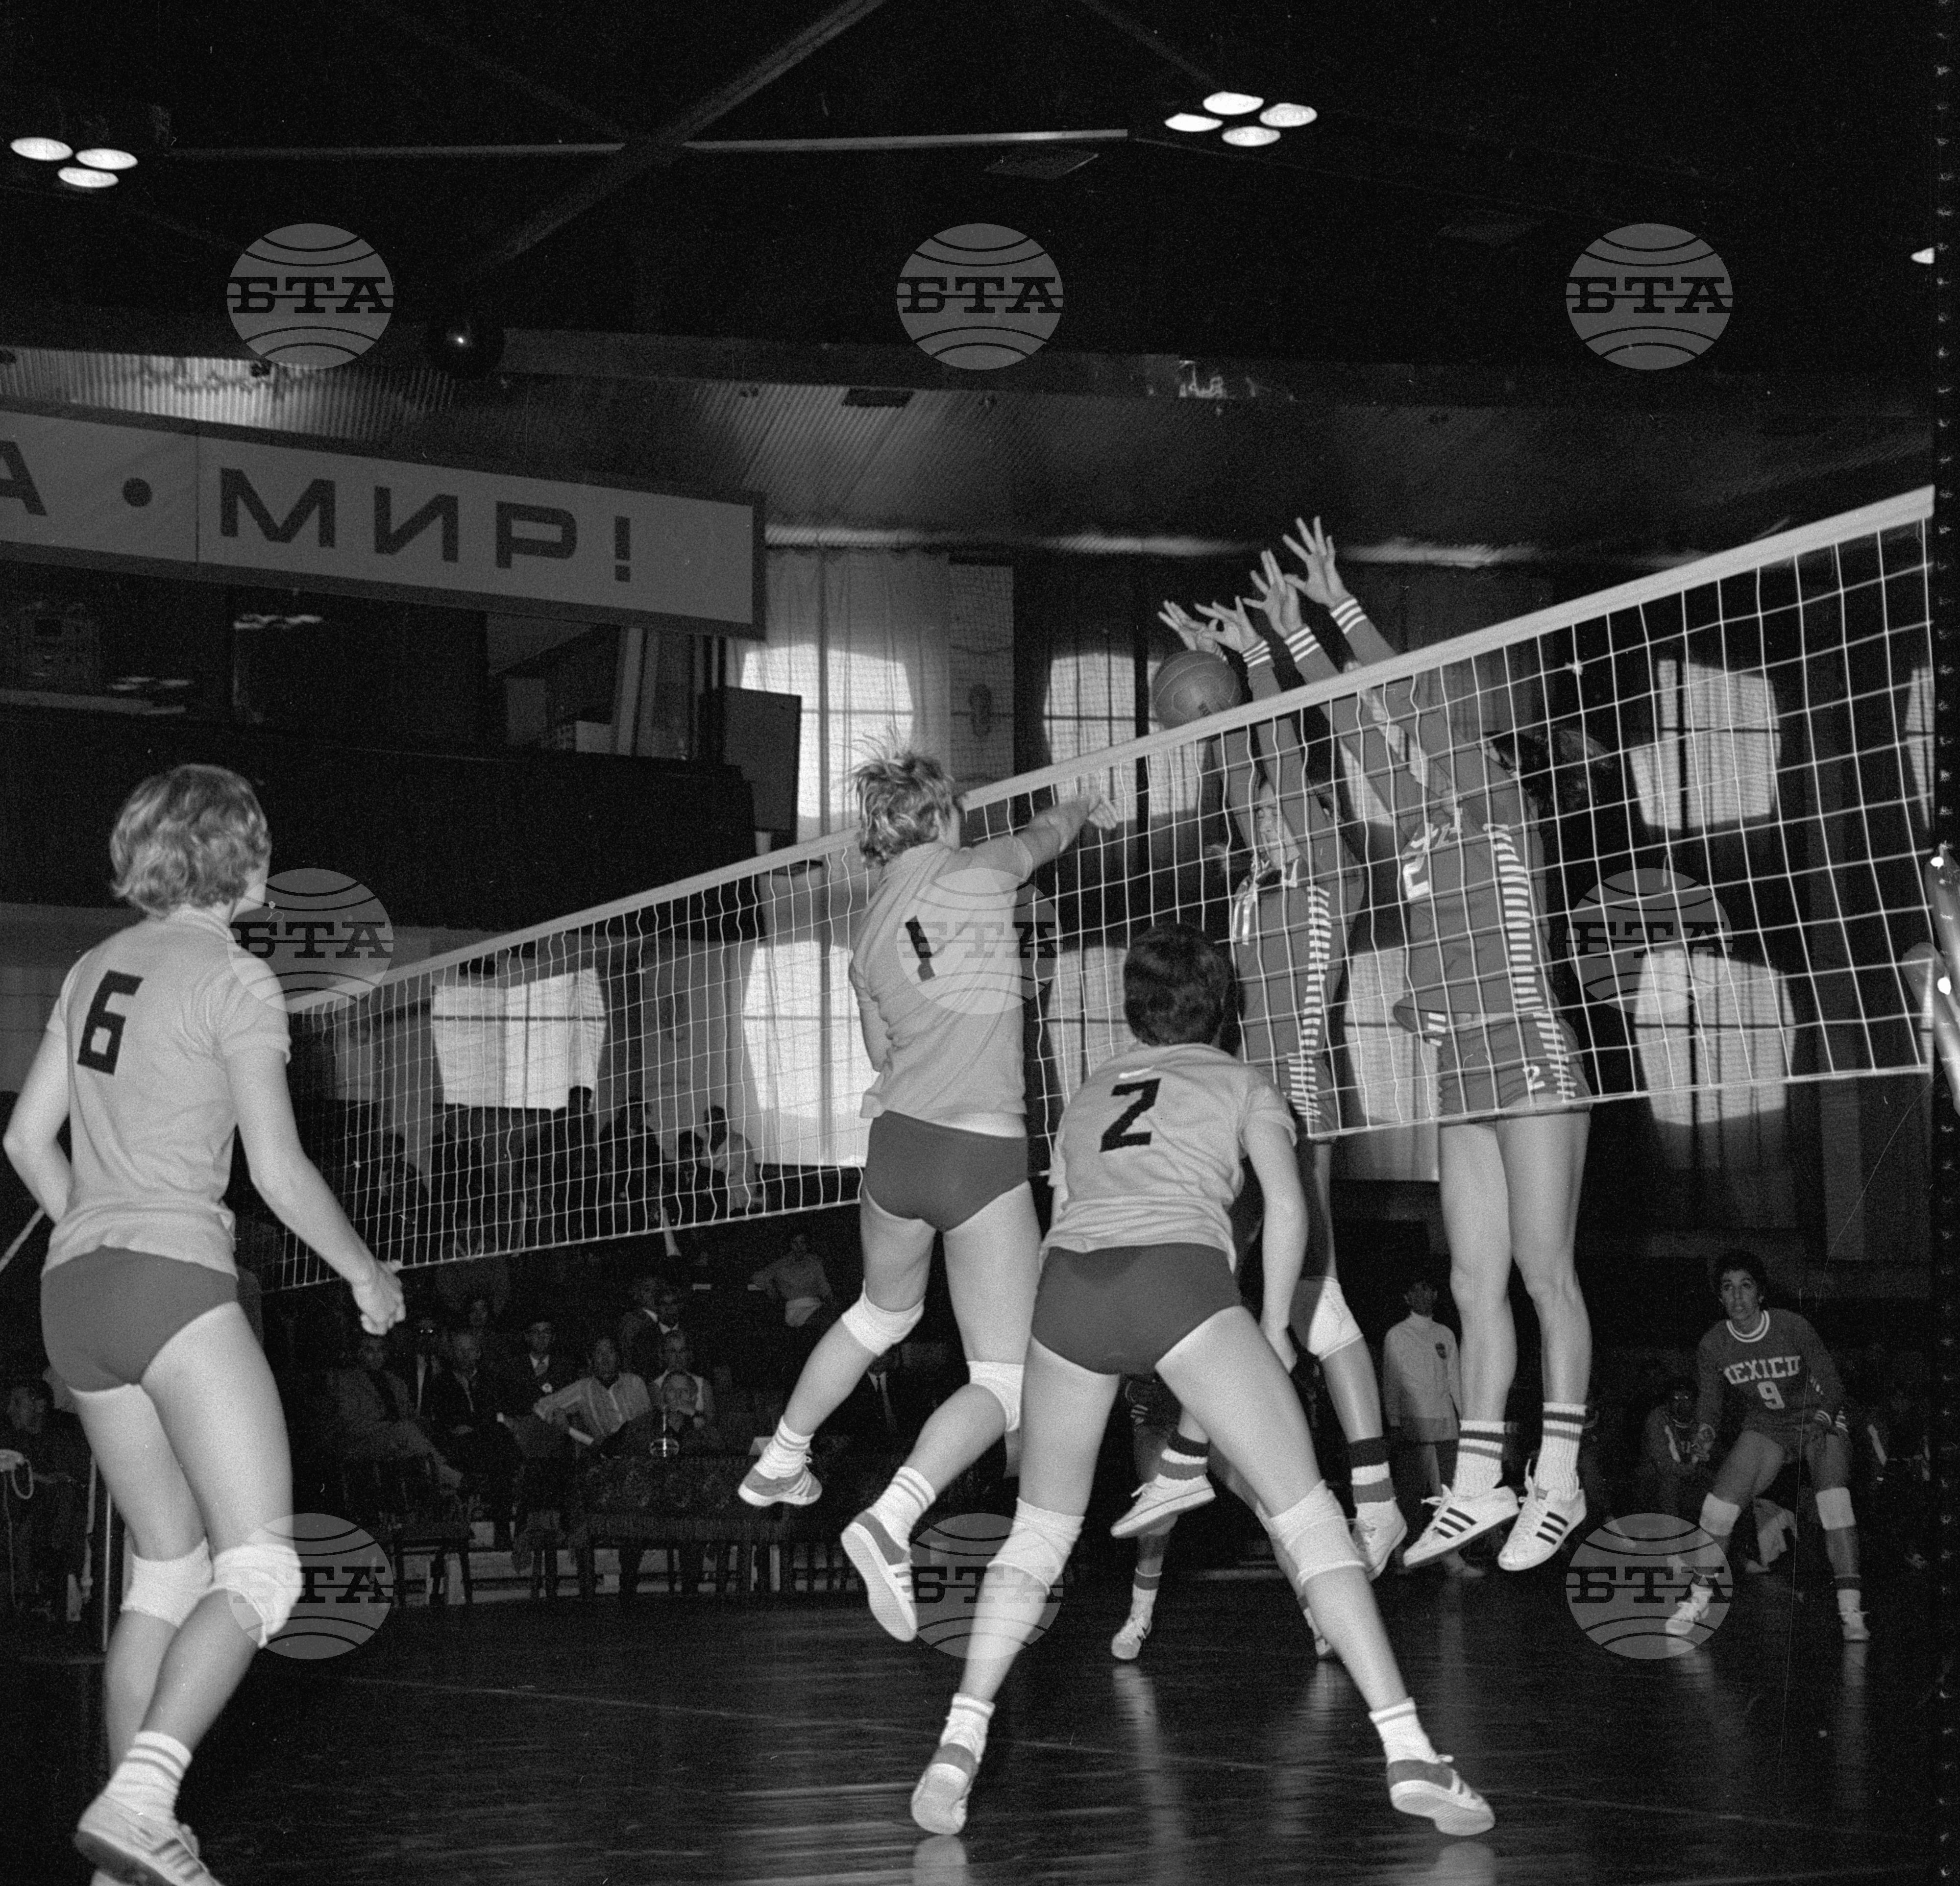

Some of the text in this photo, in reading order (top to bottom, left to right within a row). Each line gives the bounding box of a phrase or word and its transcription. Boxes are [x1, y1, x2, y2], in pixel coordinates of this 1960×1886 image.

[220, 467, 631, 583] МИР!
[905, 915, 936, 982] 1
[77, 969, 144, 1076] 6
[1522, 1065, 1546, 1091] 2
[1099, 1078, 1161, 1152] 2
[1757, 1381, 1785, 1410] 9
